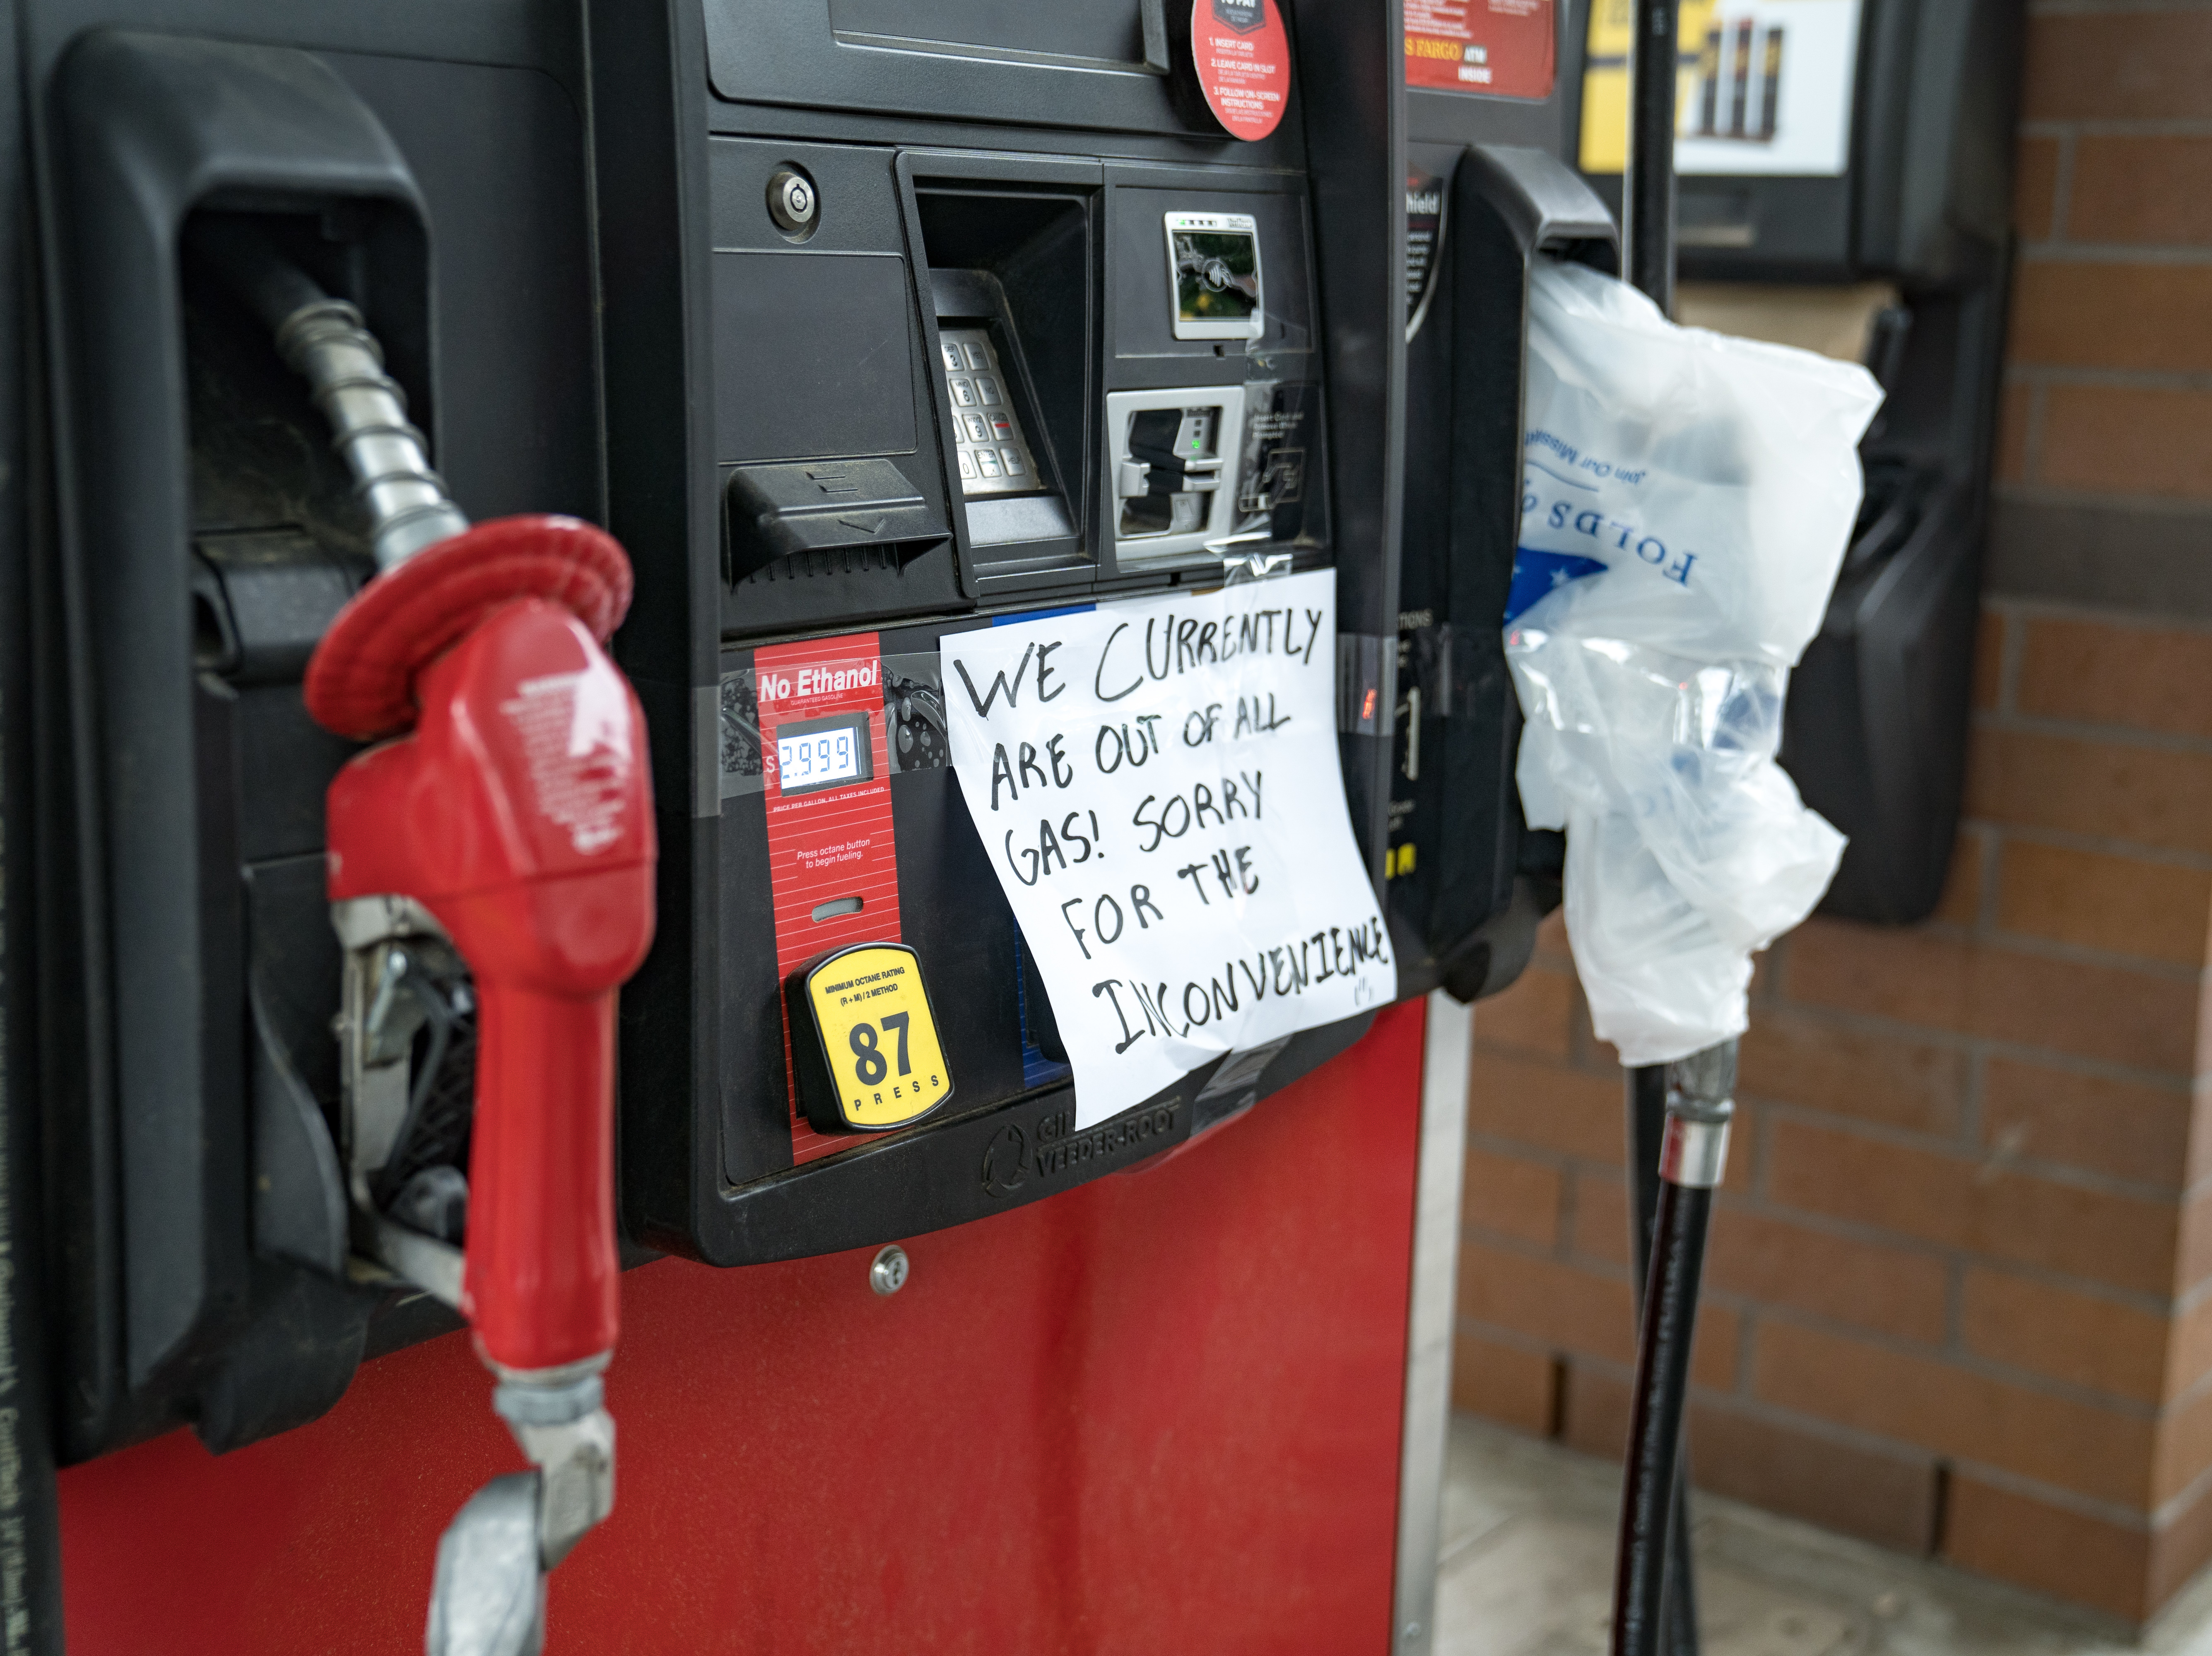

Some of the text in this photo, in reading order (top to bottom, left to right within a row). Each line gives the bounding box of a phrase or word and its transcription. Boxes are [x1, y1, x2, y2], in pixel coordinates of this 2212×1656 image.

[1215, 37, 1236, 48] INSERT
[1236, 41, 1255, 51] CARD
[1417, 39, 1463, 61] FARGO
[1217, 59, 1236, 70] LEAVE
[1236, 62, 1253, 72] CARD
[1260, 64, 1276, 74] SLOT
[1458, 66, 1492, 84] INSIDE
[1219, 87, 1244, 97] FOLLOW
[1245, 89, 1281, 101] ON-SCREEN
[1221, 97, 1264, 110] INSTRUCTIONS
[1406, 192, 1441, 214] hield
[950, 355, 958, 367] 3
[963, 390, 970, 402] 6
[975, 426, 982, 437] 9
[963, 463, 969, 474] 0
[1547, 501, 1698, 587] FOLDS
[953, 609, 1322, 720] WE CURRENTLY
[761, 660, 877, 702] No Ethanol
[791, 697, 821, 706] GUARANTEED
[991, 692, 1292, 811] ARE OUT OF ALL
[792, 802, 802, 811] PER
[803, 798, 827, 807] GALLON,
[840, 792, 857, 800] TAXES
[858, 787, 884, 796] INCLUDED
[1005, 771, 1263, 886] GAS! SORRY
[797, 839, 870, 860] Press octane button
[806, 850, 863, 869] to begin fueling.
[1061, 846, 1259, 960] FOR THE
[825, 967, 905, 994] MINIMUM OCTANE RATING
[1092, 916, 1389, 1054] INCONVENIENCE
[840, 997, 848, 1007] (R
[853, 993, 862, 1002] M)
[871, 983, 898, 996] METHOD
[849, 1011, 911, 1086] 87
[1037, 1104, 1180, 1178] VEEDER-ROOT
